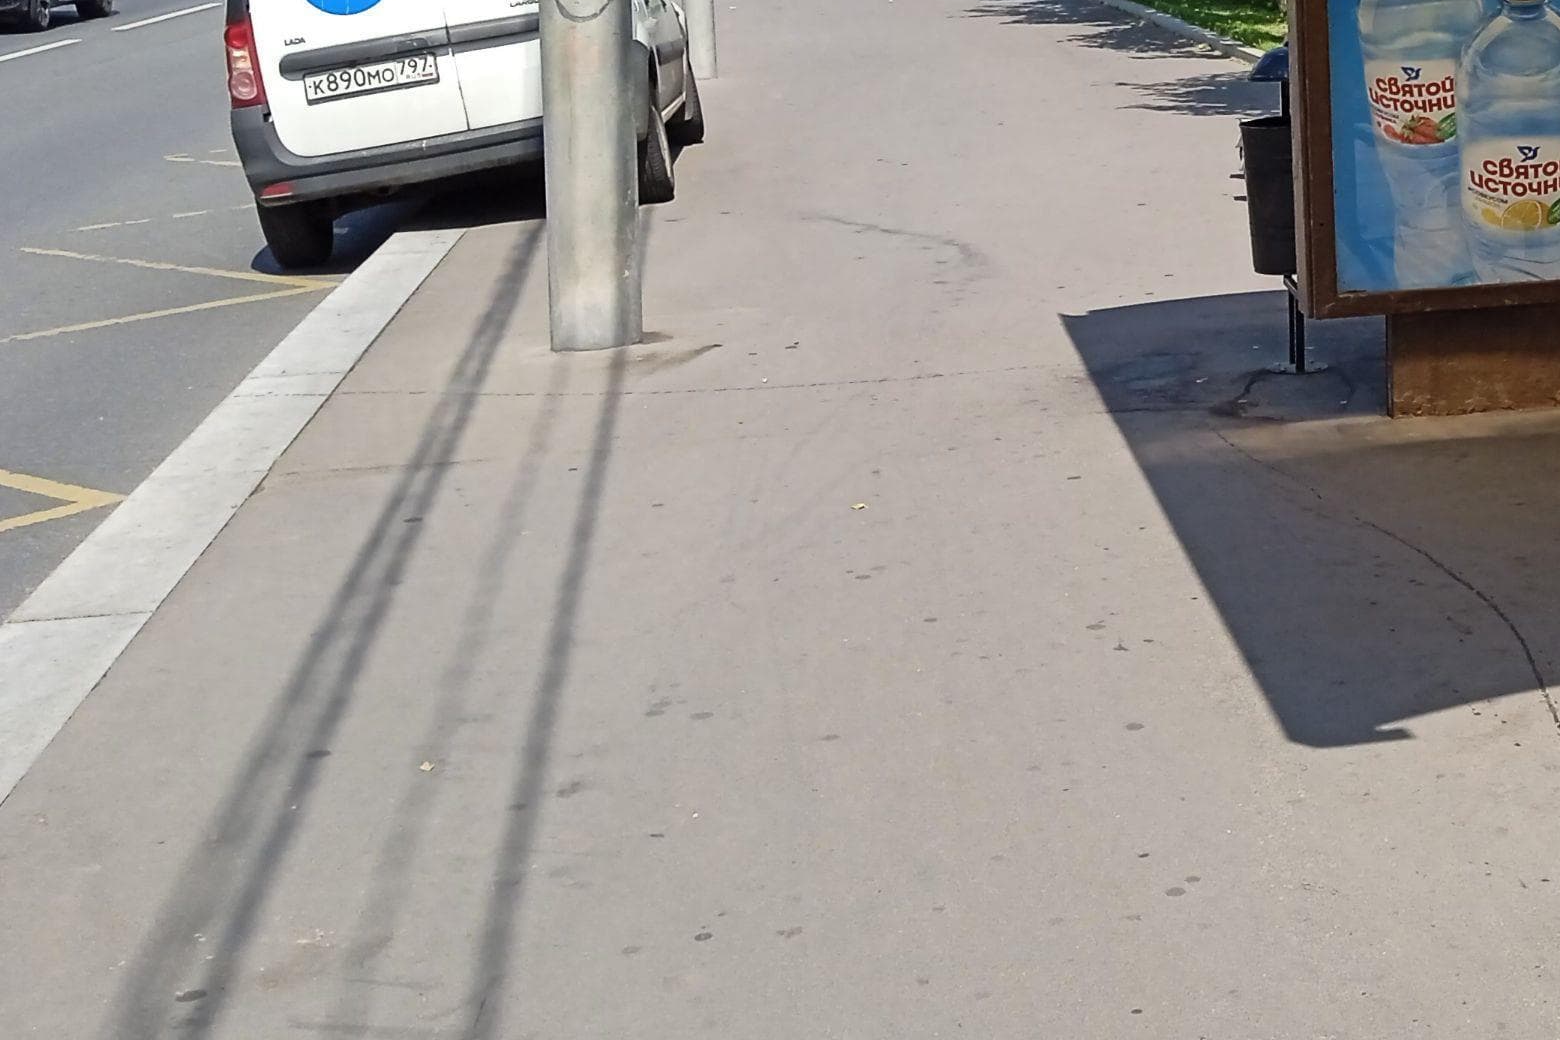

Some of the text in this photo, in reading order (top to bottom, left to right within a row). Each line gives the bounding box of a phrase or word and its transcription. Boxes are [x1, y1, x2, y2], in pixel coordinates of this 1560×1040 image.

[284, 37, 306, 47] LADA
[313, 68, 395, 95] К890МО
[1369, 87, 1456, 113] ИСТОЧНИ
